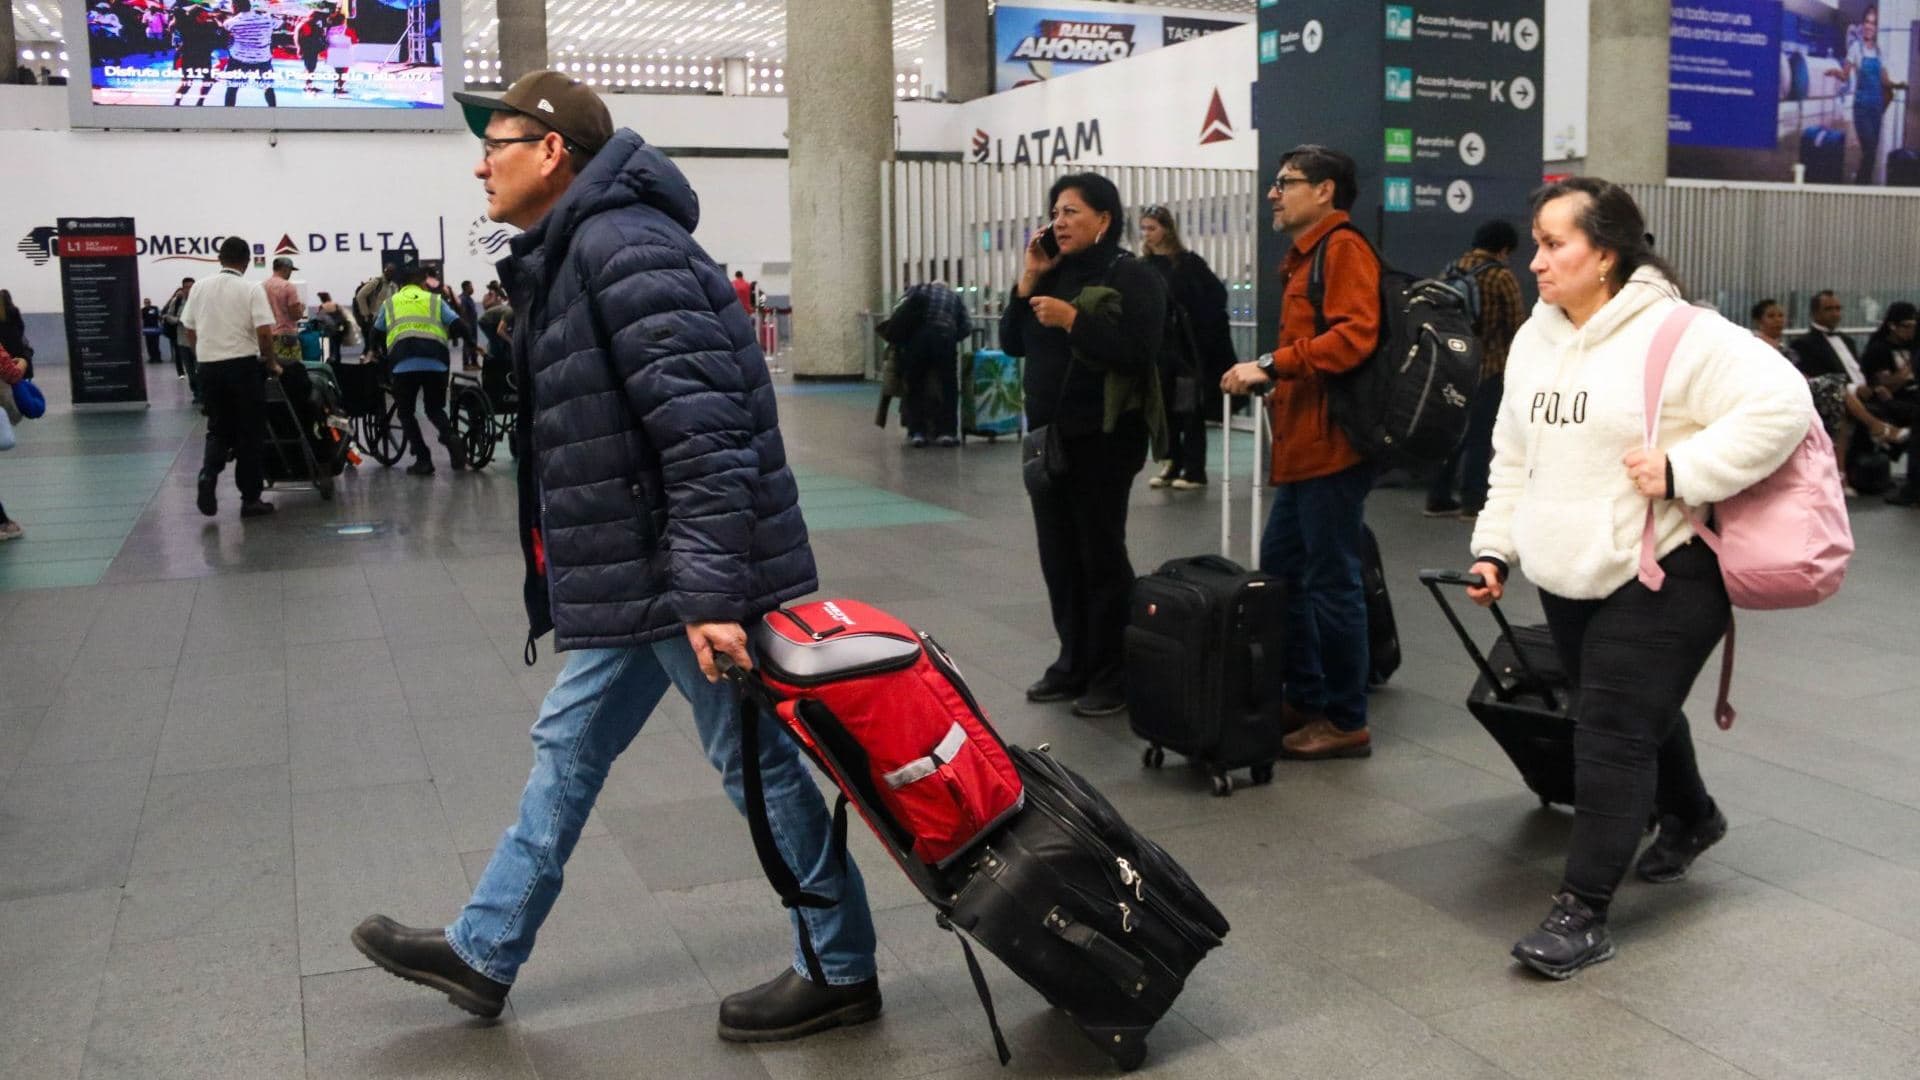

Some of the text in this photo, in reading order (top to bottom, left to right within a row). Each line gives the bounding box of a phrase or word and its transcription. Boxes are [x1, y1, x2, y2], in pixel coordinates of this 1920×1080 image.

[1059, 23, 1112, 38] RALLY
[1166, 27, 1199, 40] TASA
[1491, 20, 1510, 43] M
[1014, 37, 1128, 60] AHORRO
[104, 66, 160, 78] Disfruta
[161, 67, 183, 78] del
[211, 68, 260, 80] Festival
[1490, 80, 1505, 102] K
[997, 118, 1103, 172] LATAM
[67, 241, 80, 252] L1
[308, 232, 417, 252] DELTA
